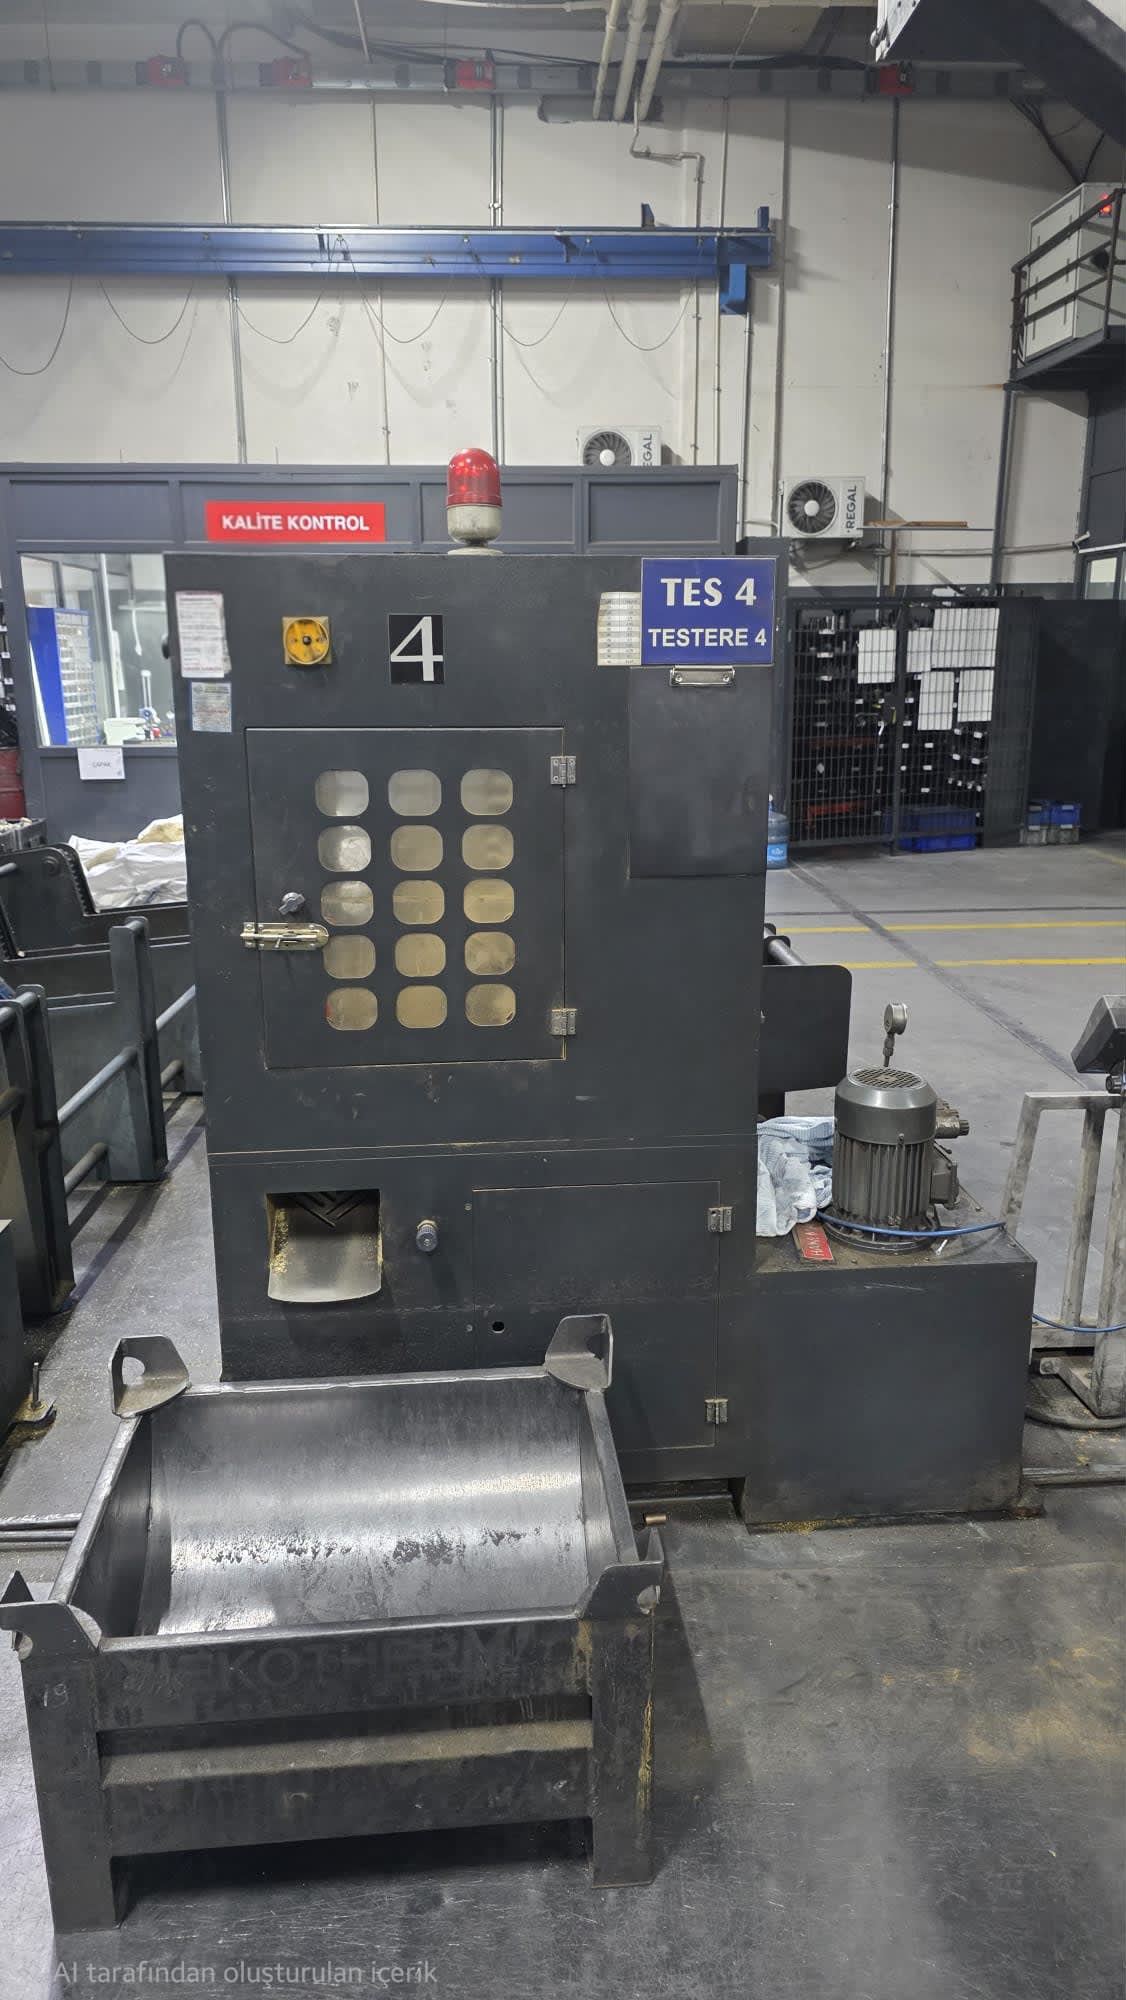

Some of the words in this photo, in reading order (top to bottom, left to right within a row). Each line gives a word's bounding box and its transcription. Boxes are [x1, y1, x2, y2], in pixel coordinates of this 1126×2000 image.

[222, 512, 283, 530] KALİTE
[288, 515, 370, 531] KONTROL
[847, 485, 857, 529] REGAL
[660, 577, 723, 607] TES
[735, 578, 757, 606] 4
[390, 616, 444, 682] 4
[648, 628, 749, 647] TESTERE
[754, 628, 767, 646] 4
